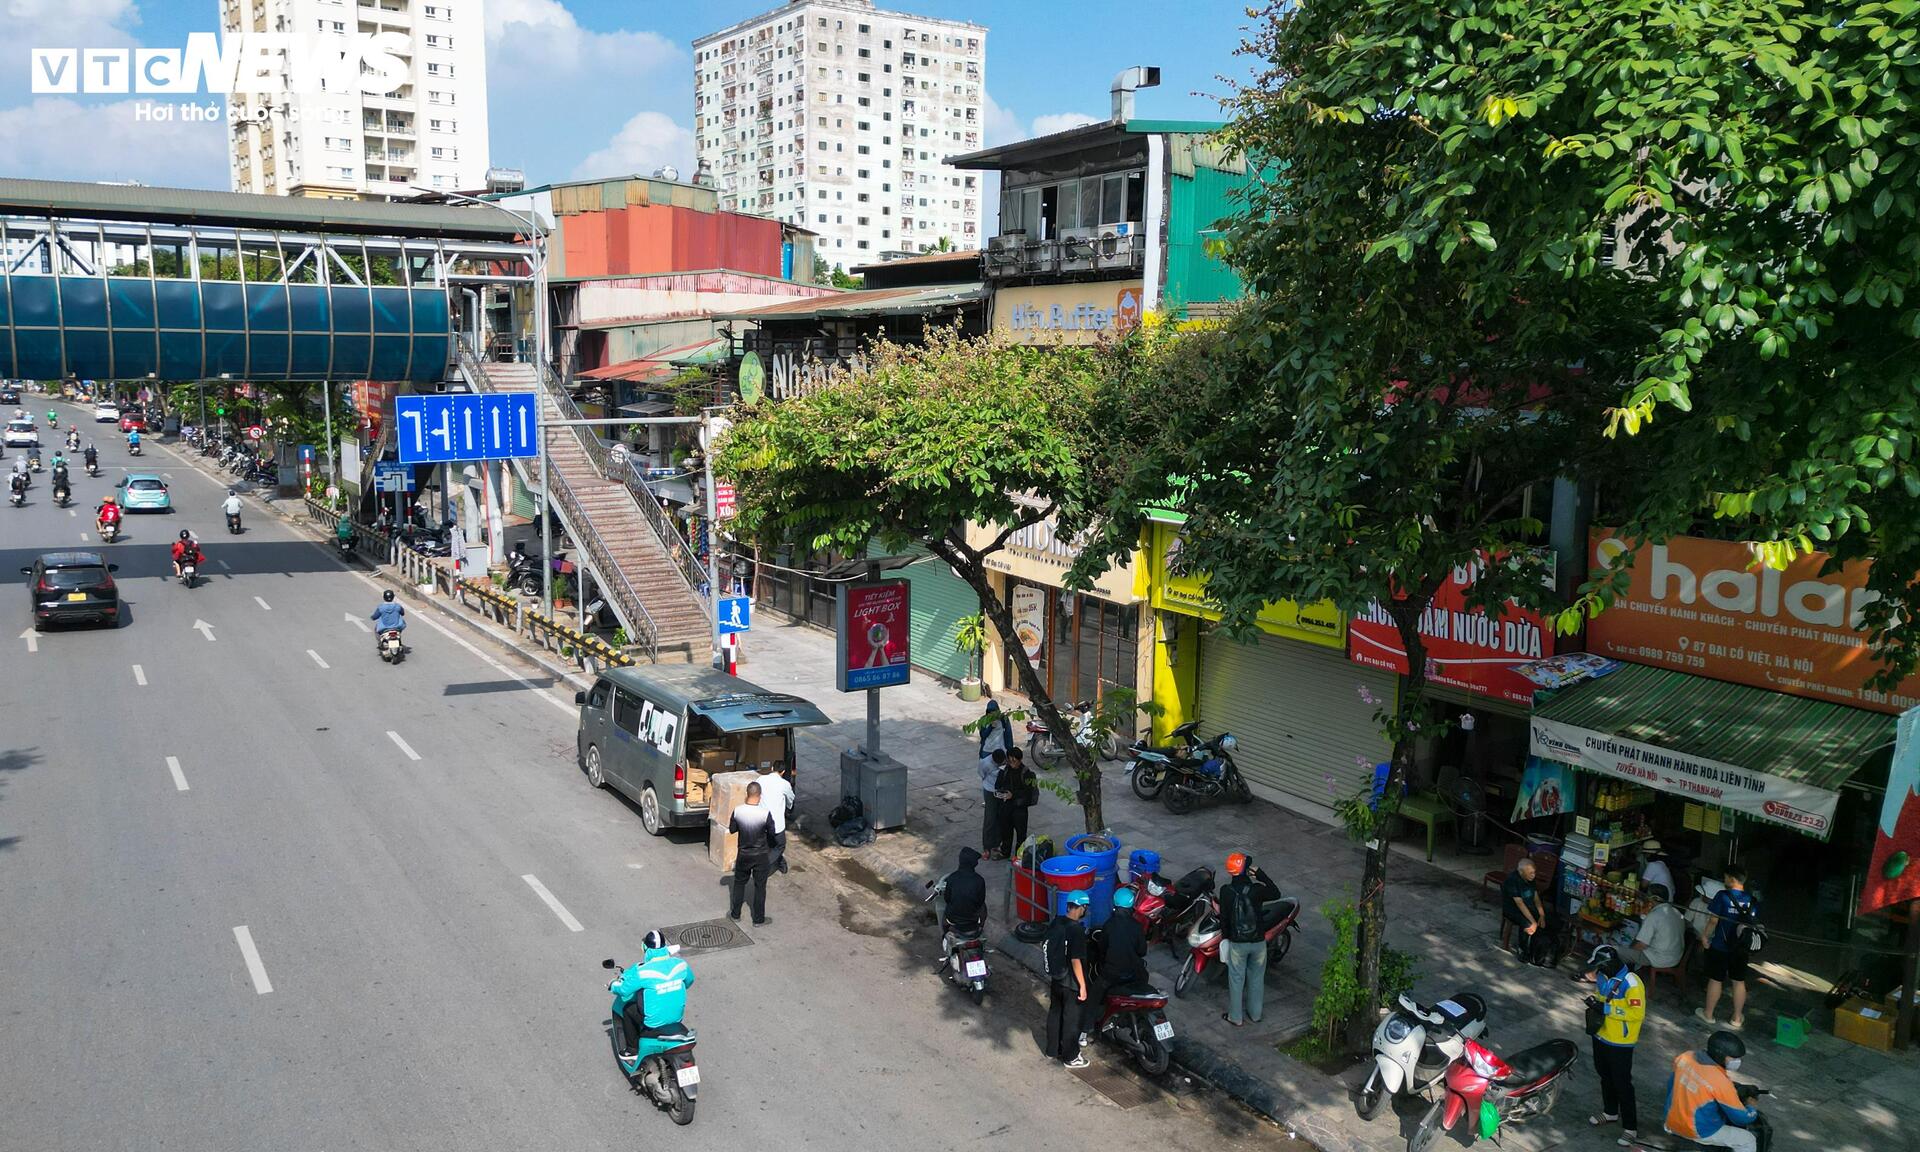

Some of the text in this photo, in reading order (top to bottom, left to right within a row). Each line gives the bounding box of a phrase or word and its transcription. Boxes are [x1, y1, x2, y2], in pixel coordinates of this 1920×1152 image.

[1050, 303, 1117, 331] Buffet
[853, 605, 880, 618] LIGHT
[881, 602, 902, 613] BOX
[865, 589, 896, 601] TIẾT KIỆM
[1453, 610, 1500, 650] NƯỚC
[1505, 617, 1542, 659] DỪA
[1630, 600, 1667, 616] CHUYỂN
[1670, 608, 1697, 620] HÀNH
[1700, 611, 1735, 626] KHÁCH
[1745, 619, 1788, 636] CHUYỂN
[1790, 627, 1820, 641] PHÁT
[1823, 632, 1863, 648] NHANH
[1639, 646, 1663, 660] 0989
[1666, 651, 1684, 664] 759
[1687, 654, 1705, 668] 759
[1693, 641, 1705, 653] 87
[1708, 644, 1726, 659] ĐẠI
[1730, 646, 1744, 660] CỒ
[1775, 654, 1790, 669] HÀ
[1794, 659, 1814, 674] NỘI
[1777, 676, 1806, 689] CHUYỂN
[1806, 681, 1825, 692] PHÁT
[1585, 736, 1618, 755] CHUYỂN
[1618, 744, 1640, 761] PHÁT
[1641, 753, 1673, 770] NHANH
[1673, 758, 1698, 776] HÀNG
[1700, 766, 1718, 781] HOÁ
[1720, 770, 1742, 787] LIÊN
[1615, 762, 1637, 776] TUYẾN
[1636, 767, 1646, 778] HÀ
[1646, 769, 1658, 781] NỘI
[1679, 779, 1688, 790] TP
[1688, 781, 1710, 796] THANH
